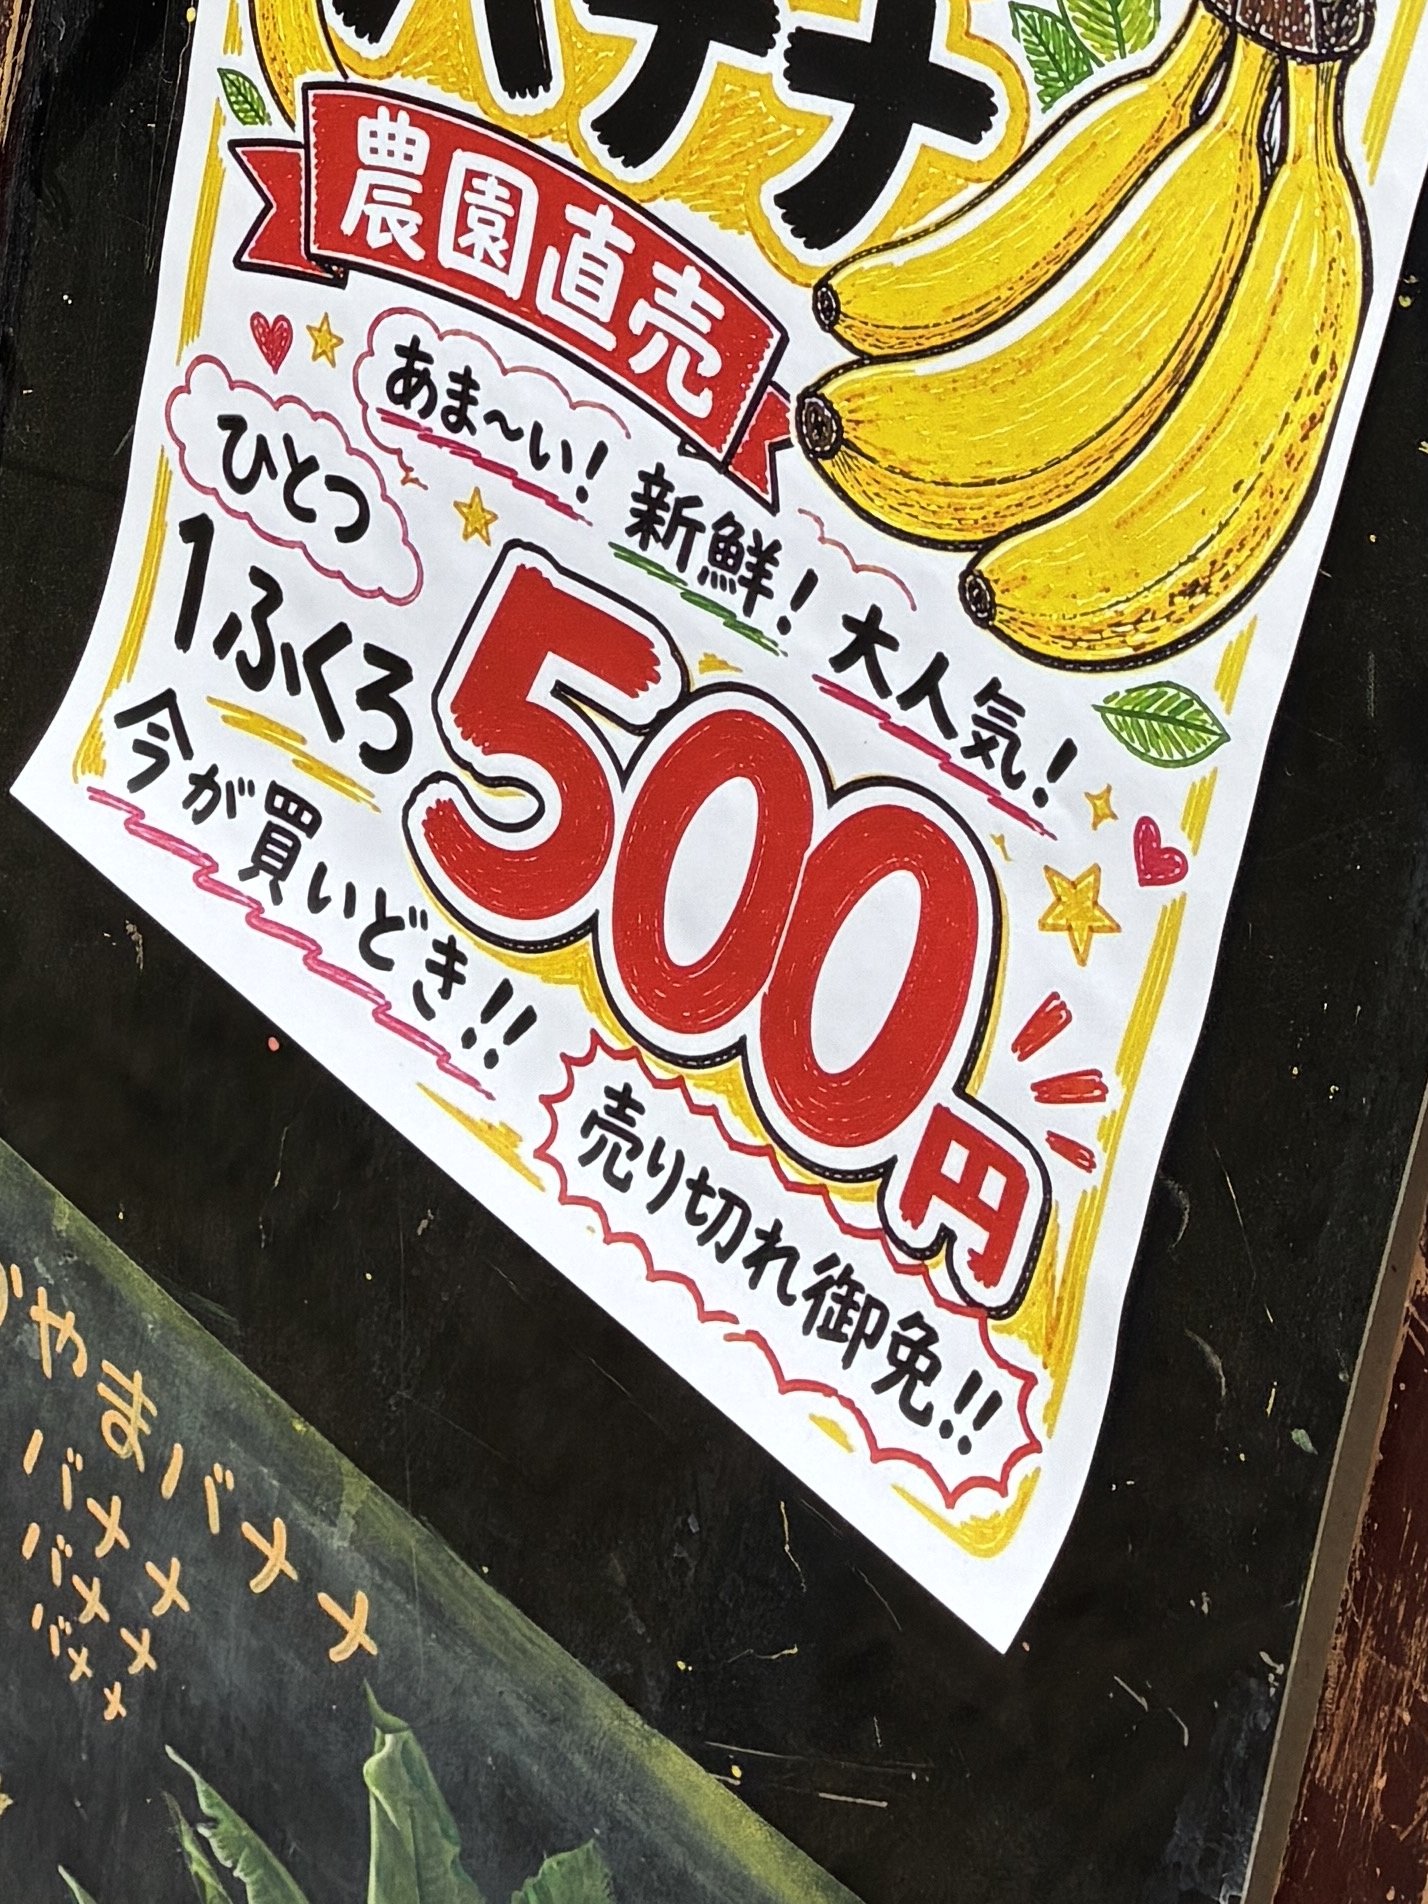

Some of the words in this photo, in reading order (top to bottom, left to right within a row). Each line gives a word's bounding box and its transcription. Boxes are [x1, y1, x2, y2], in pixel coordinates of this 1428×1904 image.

[343, 105, 728, 420] 農園直売
[216, 413, 371, 544] ひとつ
[624, 462, 815, 640] 新鮮!
[824, 606, 1080, 811] 大人気!
[113, 687, 538, 1072] 今が買いどき!!
[175, 512, 415, 775] 1ふくろ
[421, 563, 1029, 1285] 500円
[577, 1082, 1005, 1457] 売り切れ御免!!
